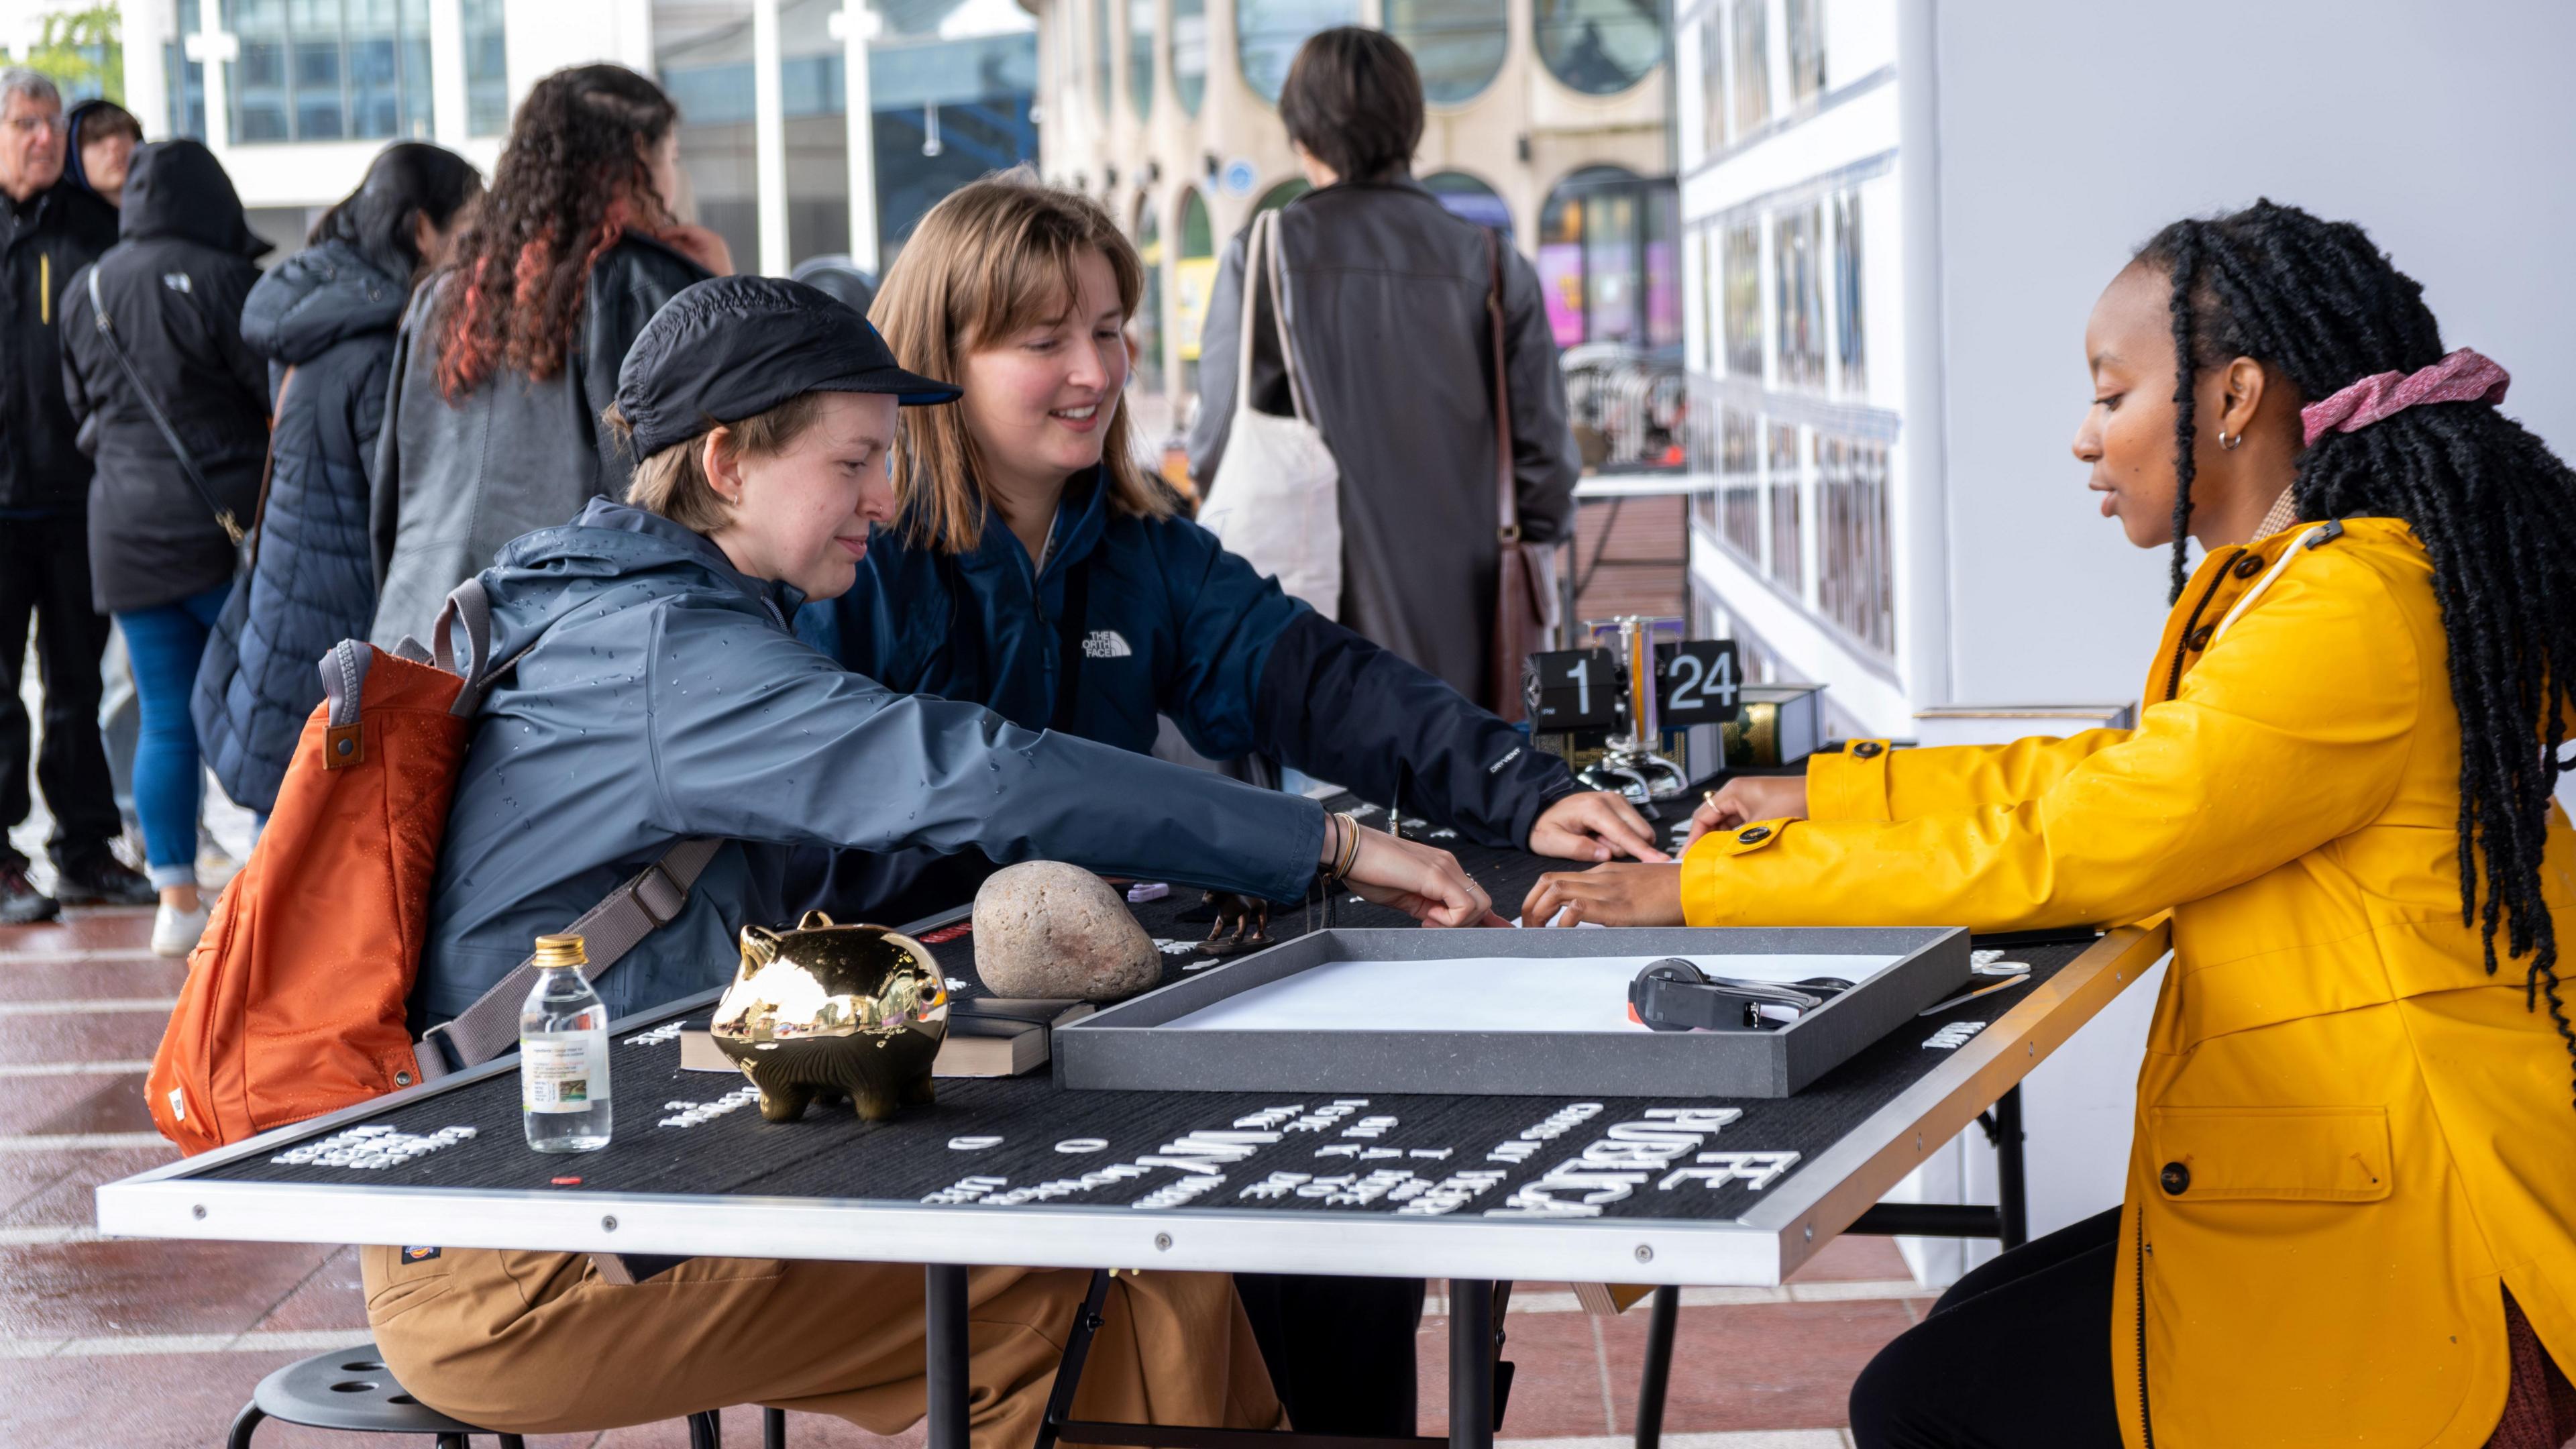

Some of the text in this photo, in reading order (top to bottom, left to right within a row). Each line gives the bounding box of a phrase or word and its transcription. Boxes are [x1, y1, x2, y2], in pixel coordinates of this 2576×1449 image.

[1089, 631, 1110, 640] THE
[1082, 639, 1110, 649] ORTH
[1086, 648, 1112, 658] FACE
[1566, 651, 1737, 714] 1 24
